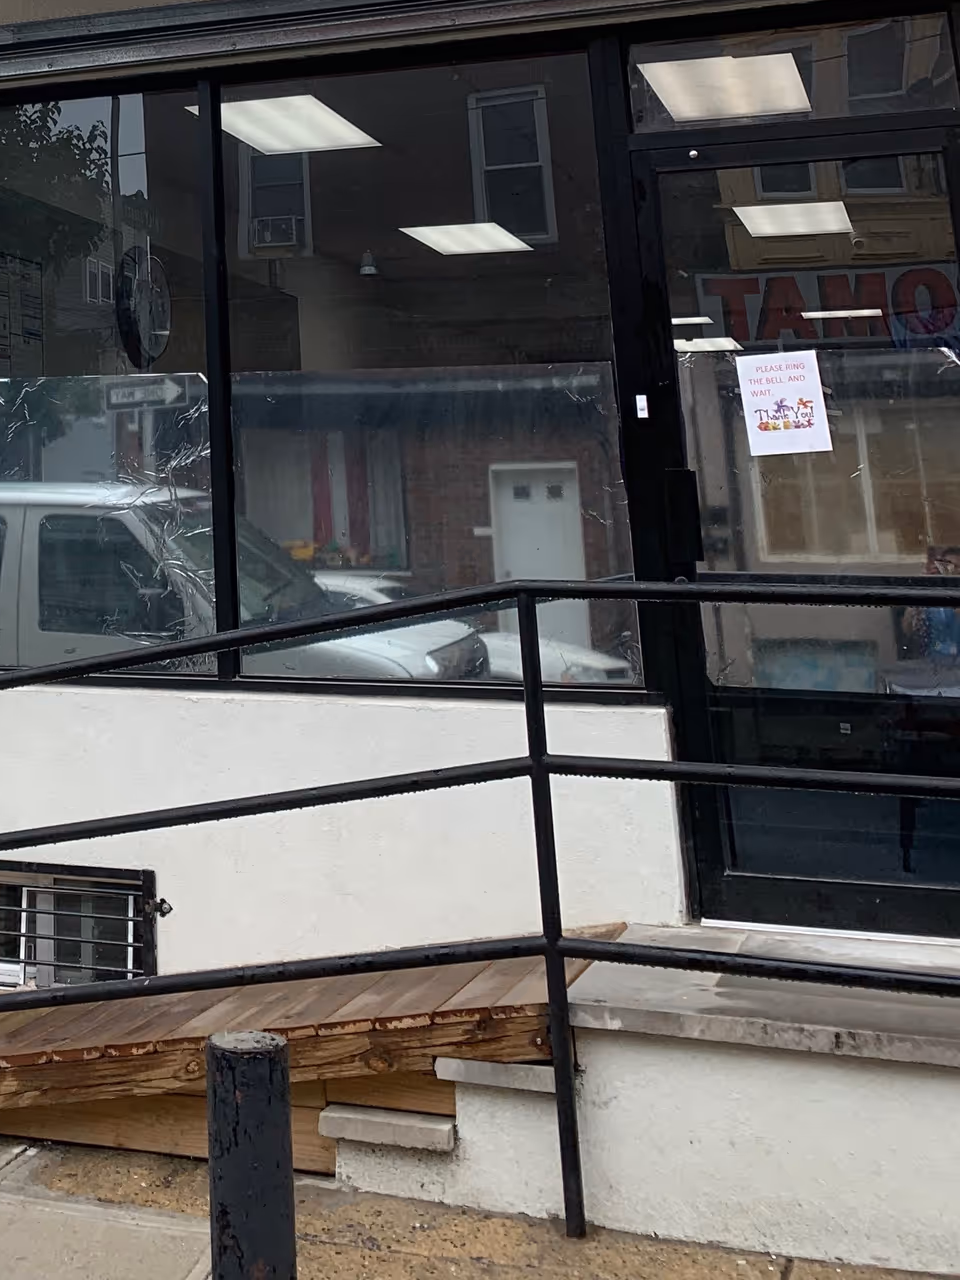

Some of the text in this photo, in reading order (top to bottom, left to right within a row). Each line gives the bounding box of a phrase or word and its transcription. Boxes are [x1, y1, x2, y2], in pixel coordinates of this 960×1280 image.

[755, 362, 806, 373] PLEASE RING
[748, 378, 766, 386] THE
[787, 374, 806, 383] AND
[754, 406, 815, 421] Thank You!
